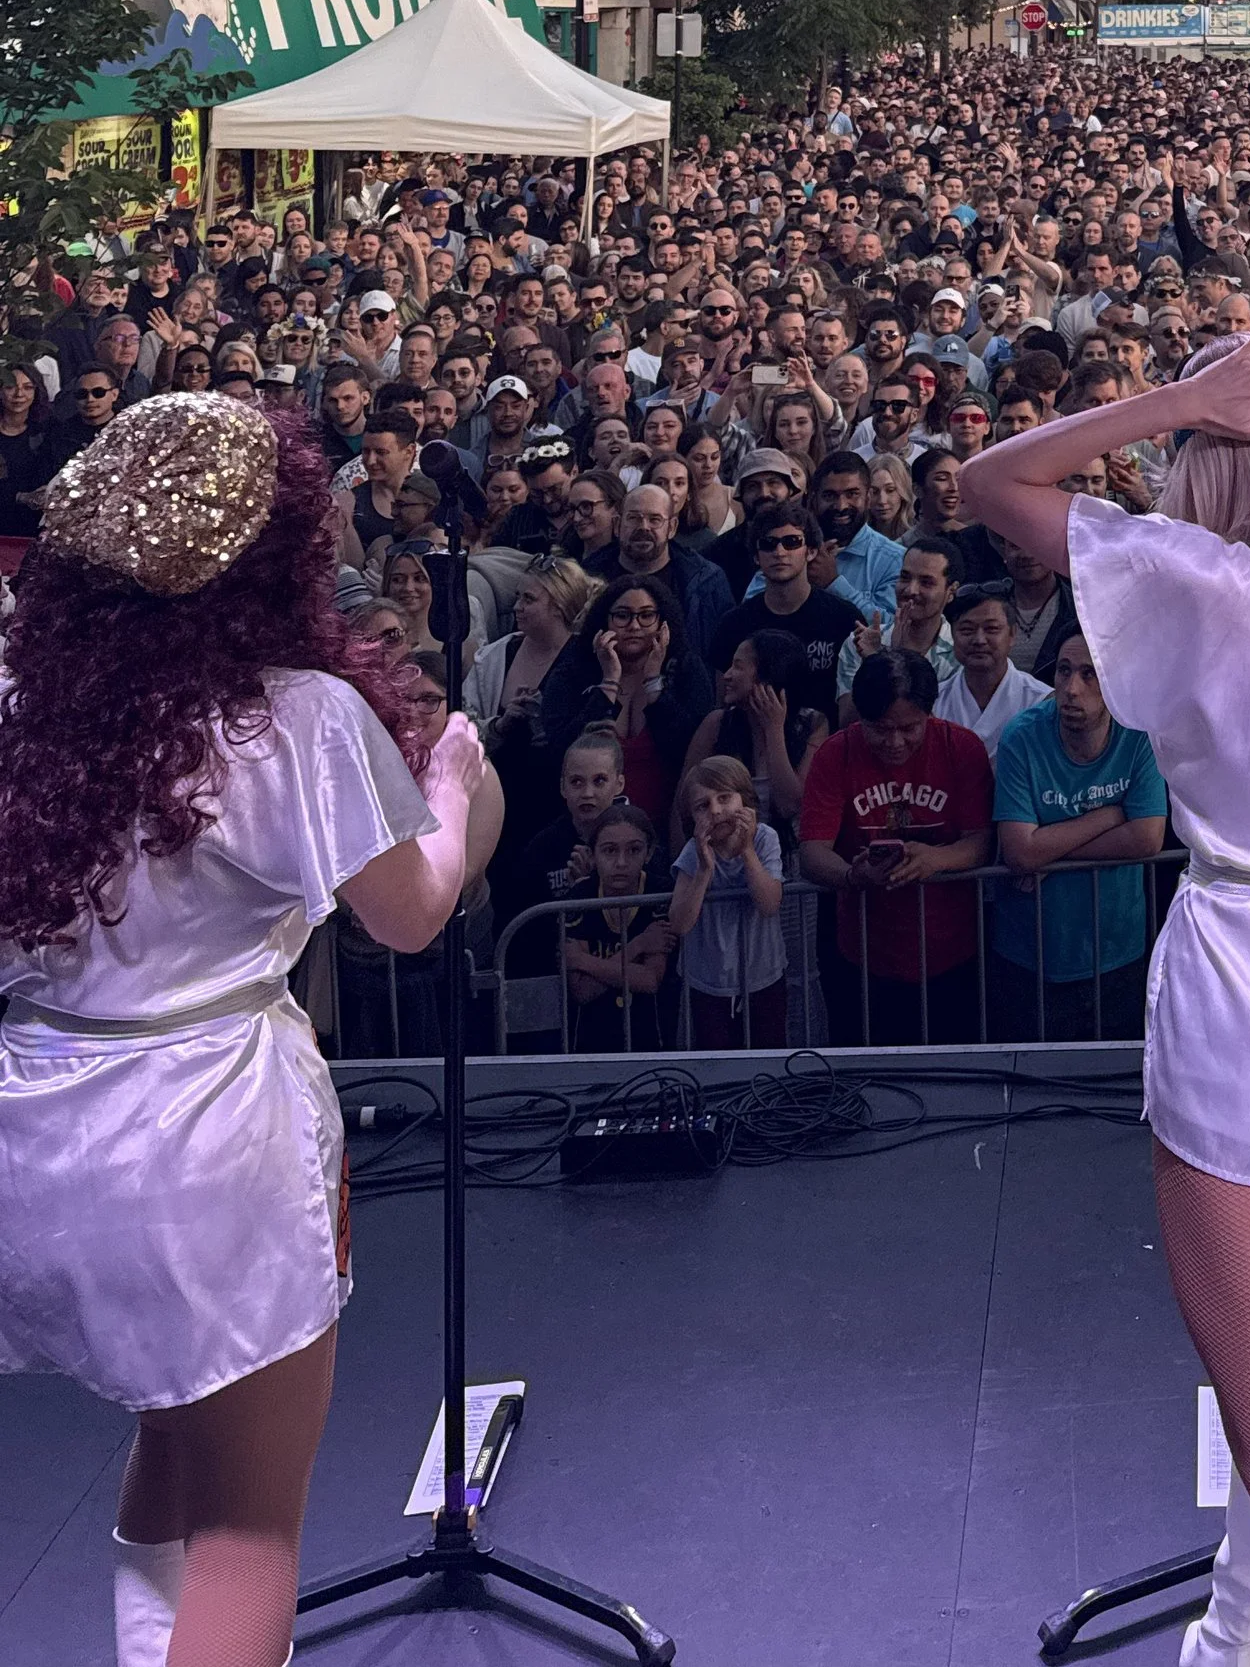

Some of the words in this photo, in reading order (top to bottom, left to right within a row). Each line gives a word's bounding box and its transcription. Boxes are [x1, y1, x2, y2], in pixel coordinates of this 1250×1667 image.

[1022, 12, 1044, 23] STOP
[1101, 8, 1180, 28] DRINKIES
[853, 781, 949, 816] CHICAGO
[1042, 789, 1068, 809] City
